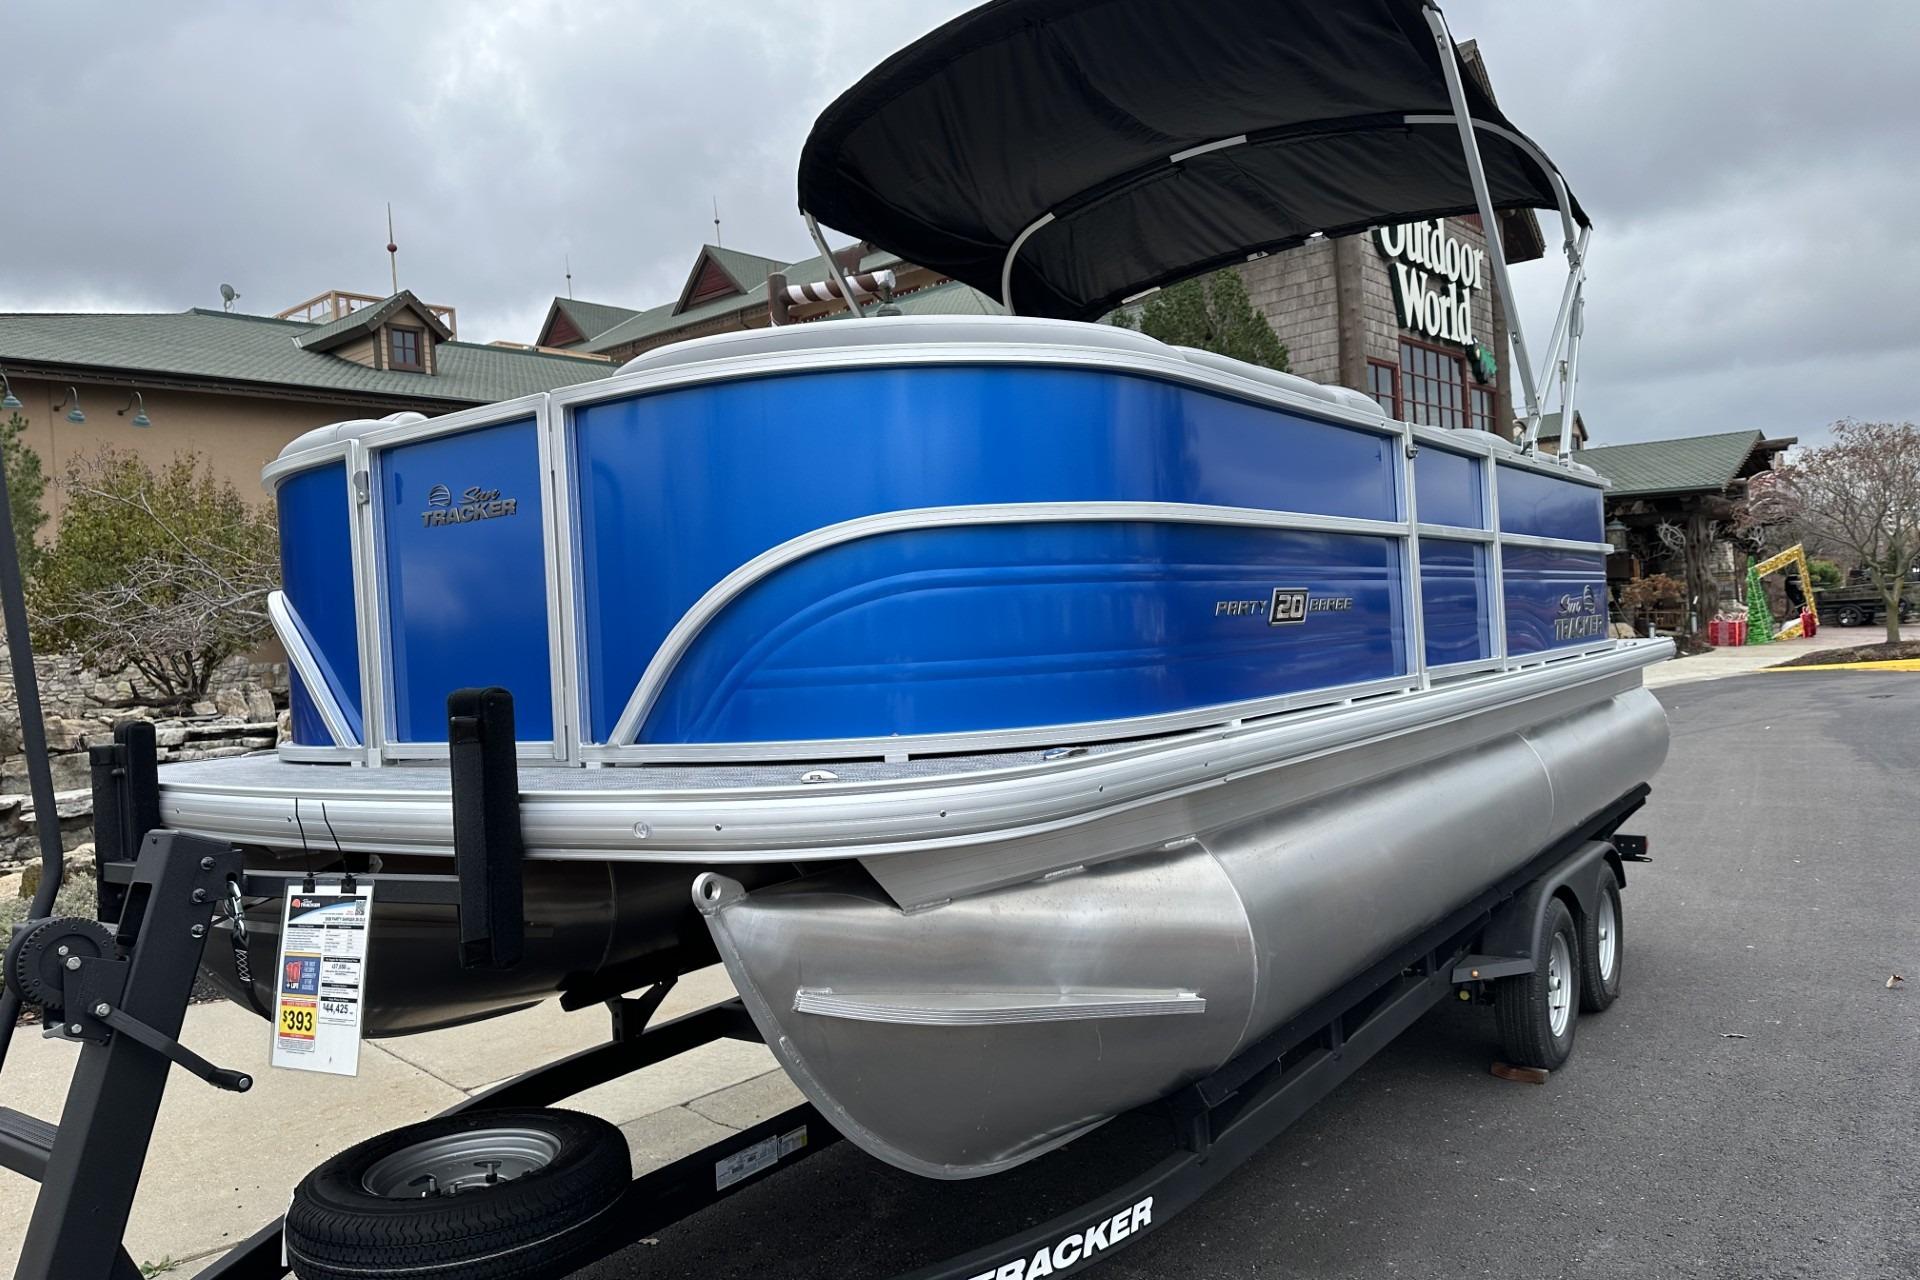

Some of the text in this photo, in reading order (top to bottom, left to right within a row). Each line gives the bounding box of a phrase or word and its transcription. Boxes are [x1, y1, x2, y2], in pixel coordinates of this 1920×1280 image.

[1396, 262, 1474, 345] World
[459, 486, 500, 504] Sun
[422, 498, 517, 528] TRACKER
[1215, 594, 1352, 619] PARTY 20 BARGE
[1554, 614, 1602, 641] TRACKER
[282, 1010, 313, 1032] $393
[322, 1002, 349, 1015] $44,425
